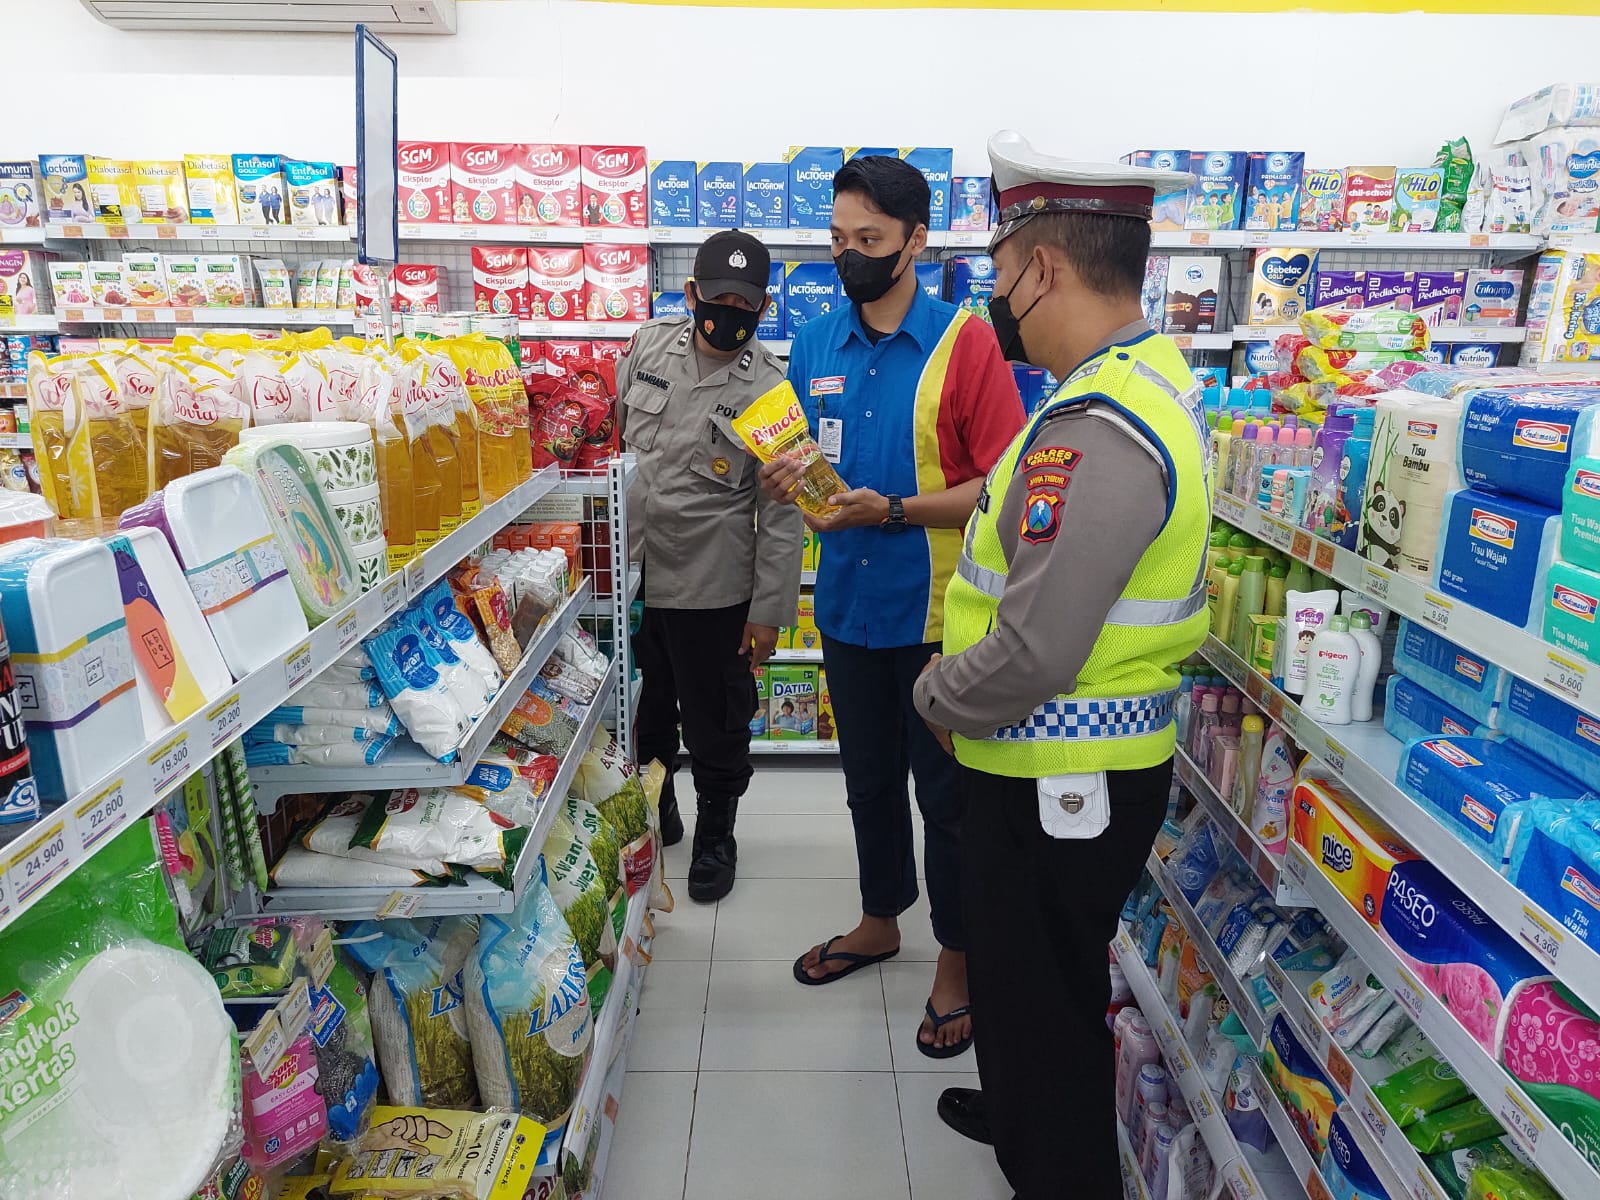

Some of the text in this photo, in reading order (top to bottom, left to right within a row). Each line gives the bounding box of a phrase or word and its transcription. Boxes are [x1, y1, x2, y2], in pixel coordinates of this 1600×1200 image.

[237, 159, 276, 170] Entrasol
[400, 148, 432, 166] SGM
[466, 149, 498, 167] SGM
[531, 150, 563, 168] SGM
[597, 151, 629, 170] SGM
[45, 161, 80, 174] Lactamil
[89, 163, 132, 174] Diabetasol
[137, 166, 179, 176] Diabetasol
[188, 160, 229, 171] Diabetasol
[291, 166, 328, 177] Entrasol
[402, 175, 433, 185] Eksplor
[468, 176, 499, 186] Eksplor
[533, 178, 564, 187] Eksplor
[598, 179, 629, 189] Eksplor
[796, 170, 834, 183] LACTOGEN
[657, 179, 689, 191] LACTOGEN
[703, 179, 736, 191] LACTOGEN
[746, 181, 785, 192] LACTOGROW
[728, 196, 736, 209] 2
[773, 198, 782, 210] 3
[934, 190, 944, 207] 3
[485, 253, 513, 269] SGM
[541, 255, 570, 271] SGM
[599, 250, 631, 268] SGM
[405, 270, 427, 282] SGM
[1266, 263, 1303, 275] Bebelac
[485, 276, 516, 287] Eksplor
[541, 278, 573, 288] Eksplor
[600, 276, 632, 286] Eksplor
[1268, 273, 1285, 281] GOLD
[788, 283, 835, 296] LACTOGROW
[1319, 286, 1363, 302] PediaSure
[1368, 285, 1413, 302] PediaSure
[1418, 286, 1463, 302] PediaSure
[656, 306, 686, 315] LACTOGROW
[768, 302, 778, 317] 3
[1459, 353, 1490, 363] Nutrilon
[580, 380, 598, 391] ABC
[176, 394, 219, 422] Sovia
[750, 402, 803, 446] Bimoli
[1523, 429, 1558, 442] Indomaret
[1027, 447, 1073, 466] POLRES
[1411, 443, 1426, 457] Tisu
[1030, 456, 1067, 467] GRESIK
[1403, 456, 1430, 473] Bambu
[1571, 513, 1586, 526] Tisu
[1478, 520, 1507, 537] Indomaret
[1470, 542, 1508, 565] Tisu Wajah
[1560, 593, 1588, 612] Indomaret
[1432, 610, 1448, 625] 9.500
[1551, 626, 1590, 652] Tisu Wajah
[1318, 649, 1349, 661] pigeon
[773, 682, 814, 697] DATITA
[1559, 673, 1582, 692] 9.600
[217, 706, 241, 731] 20.200
[161, 746, 188, 775] 19.300
[90, 794, 123, 830] 22.600
[26, 837, 64, 878] 24.900
[1321, 833, 1353, 868] nice
[1386, 869, 1436, 928] PASEO
[1573, 907, 1589, 926] Tisu
[1563, 914, 1589, 940] Wajah
[1534, 933, 1558, 959] 4.300
[285, 1079, 306, 1095] CLEAN
[1511, 1110, 1537, 1144] 19.100
[484, 1130, 506, 1177] Shamrock
